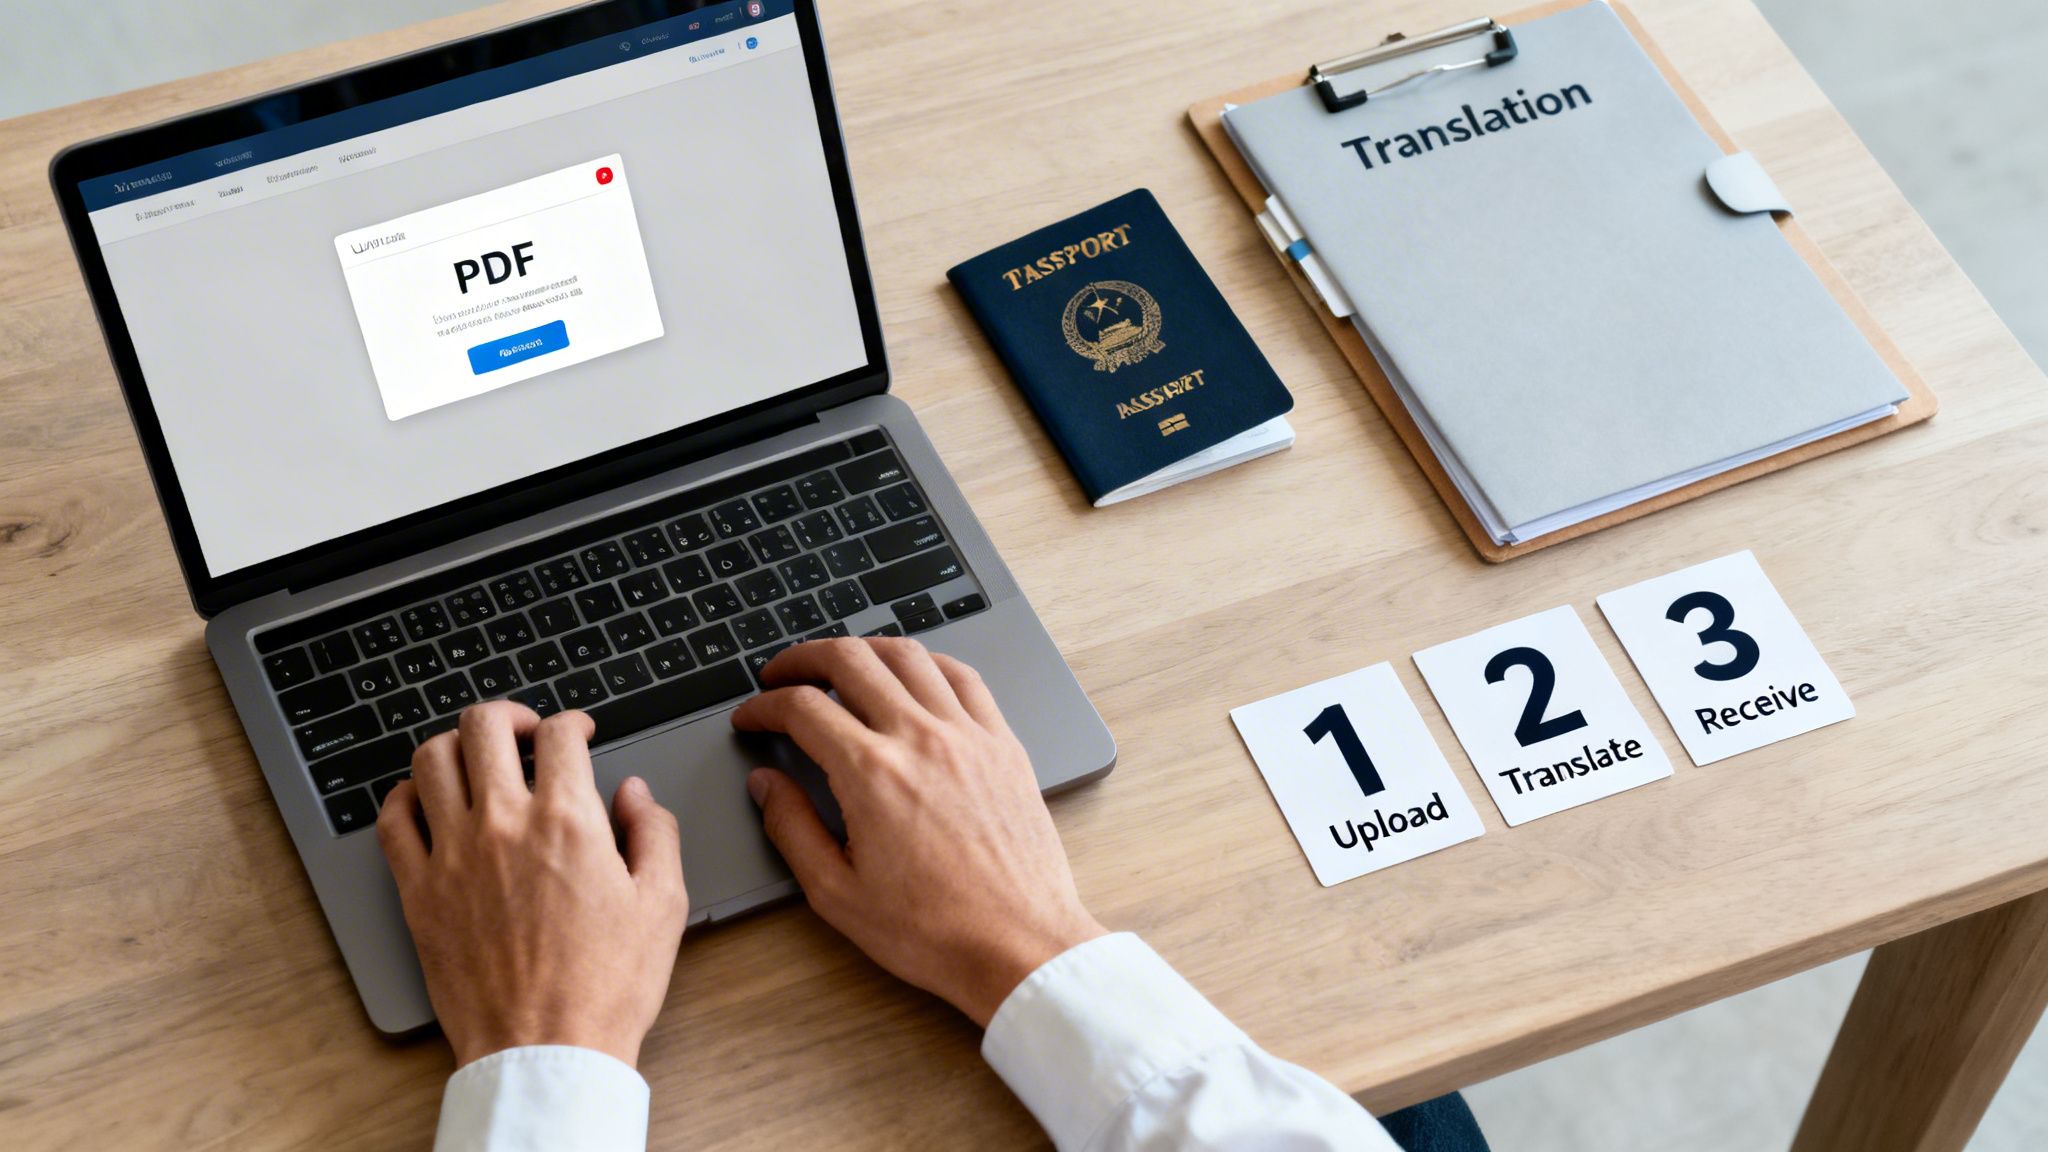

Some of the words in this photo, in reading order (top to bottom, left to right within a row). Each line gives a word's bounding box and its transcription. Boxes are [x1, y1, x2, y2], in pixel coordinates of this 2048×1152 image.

[1341, 83, 1593, 170] Translation
[454, 241, 534, 294] PDF
[1666, 591, 1760, 682] 3
[1485, 647, 1588, 747] 2
[1695, 683, 1819, 735] Receive
[1303, 703, 1386, 797] 1
[1499, 737, 1643, 796] Translate
[1330, 792, 1450, 853] Upload
